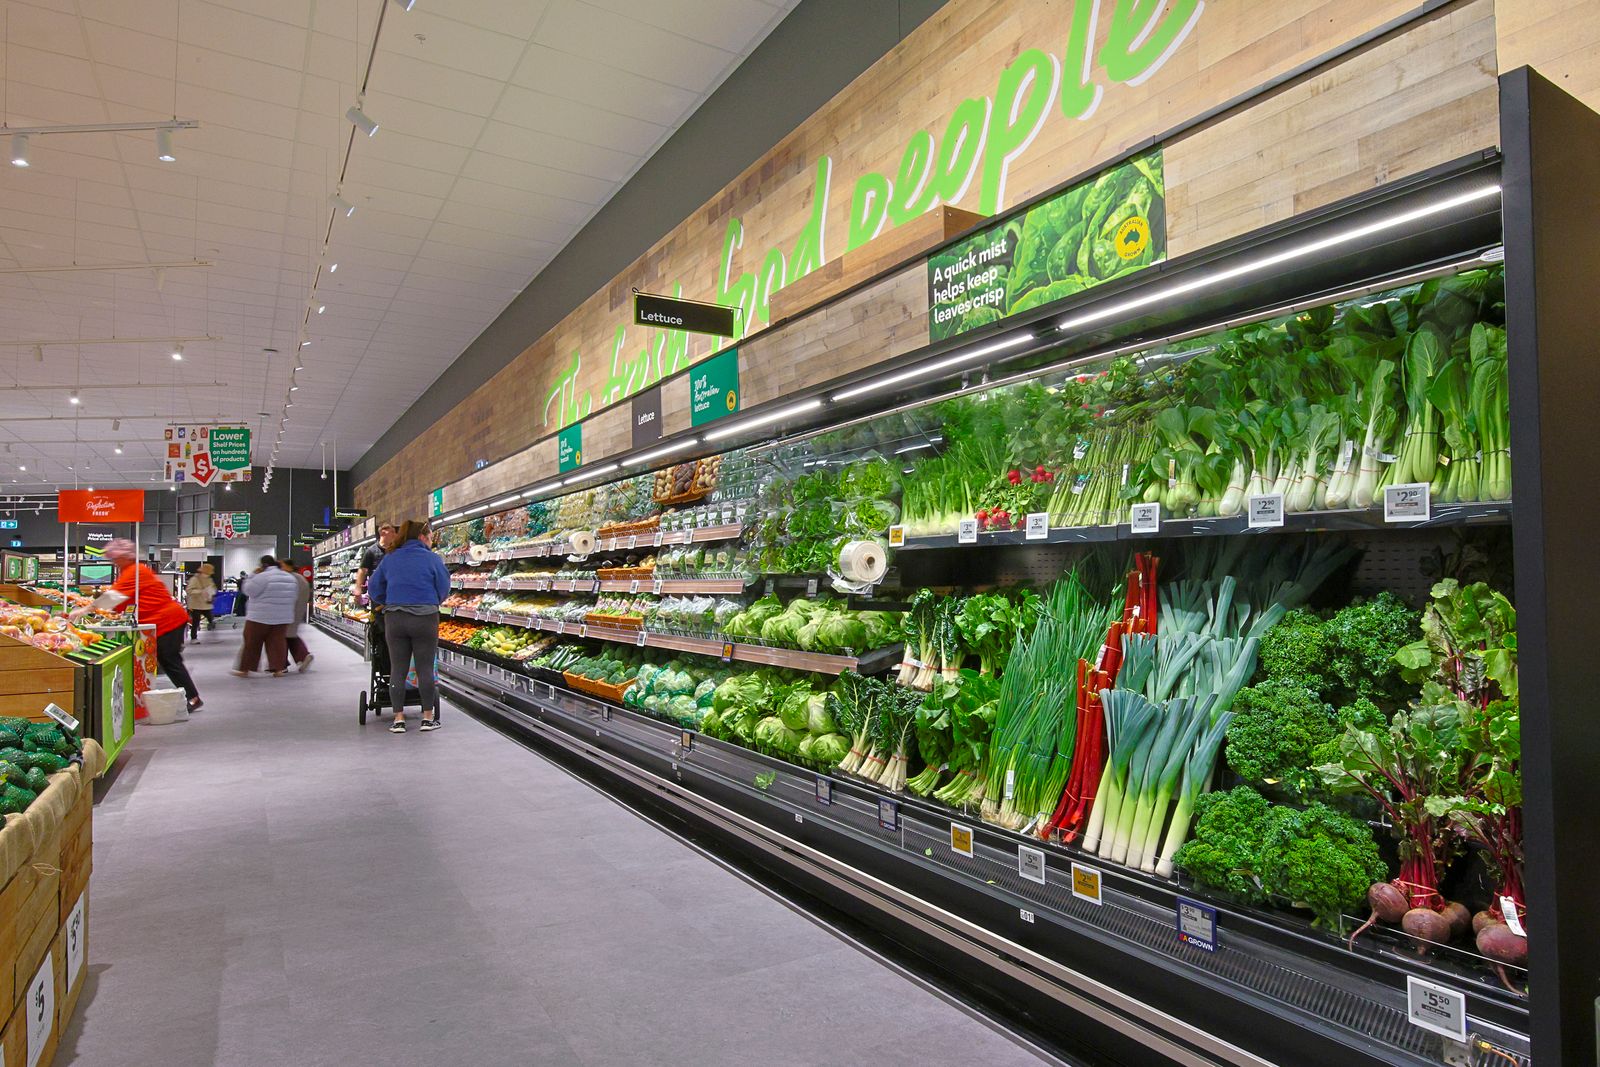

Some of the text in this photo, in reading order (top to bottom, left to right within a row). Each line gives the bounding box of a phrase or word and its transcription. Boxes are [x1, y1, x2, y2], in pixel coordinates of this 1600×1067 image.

[541, 0, 1204, 429] The fresh food people
[933, 238, 1007, 285] A quick mist
[934, 267, 998, 304] helps keep
[640, 310, 683, 325] Lettuce
[934, 287, 1004, 324] leaves crisp
[638, 410, 655, 425] Lettuce
[213, 431, 244, 440] Lower
[1187, 937, 1213, 951] GROWN
